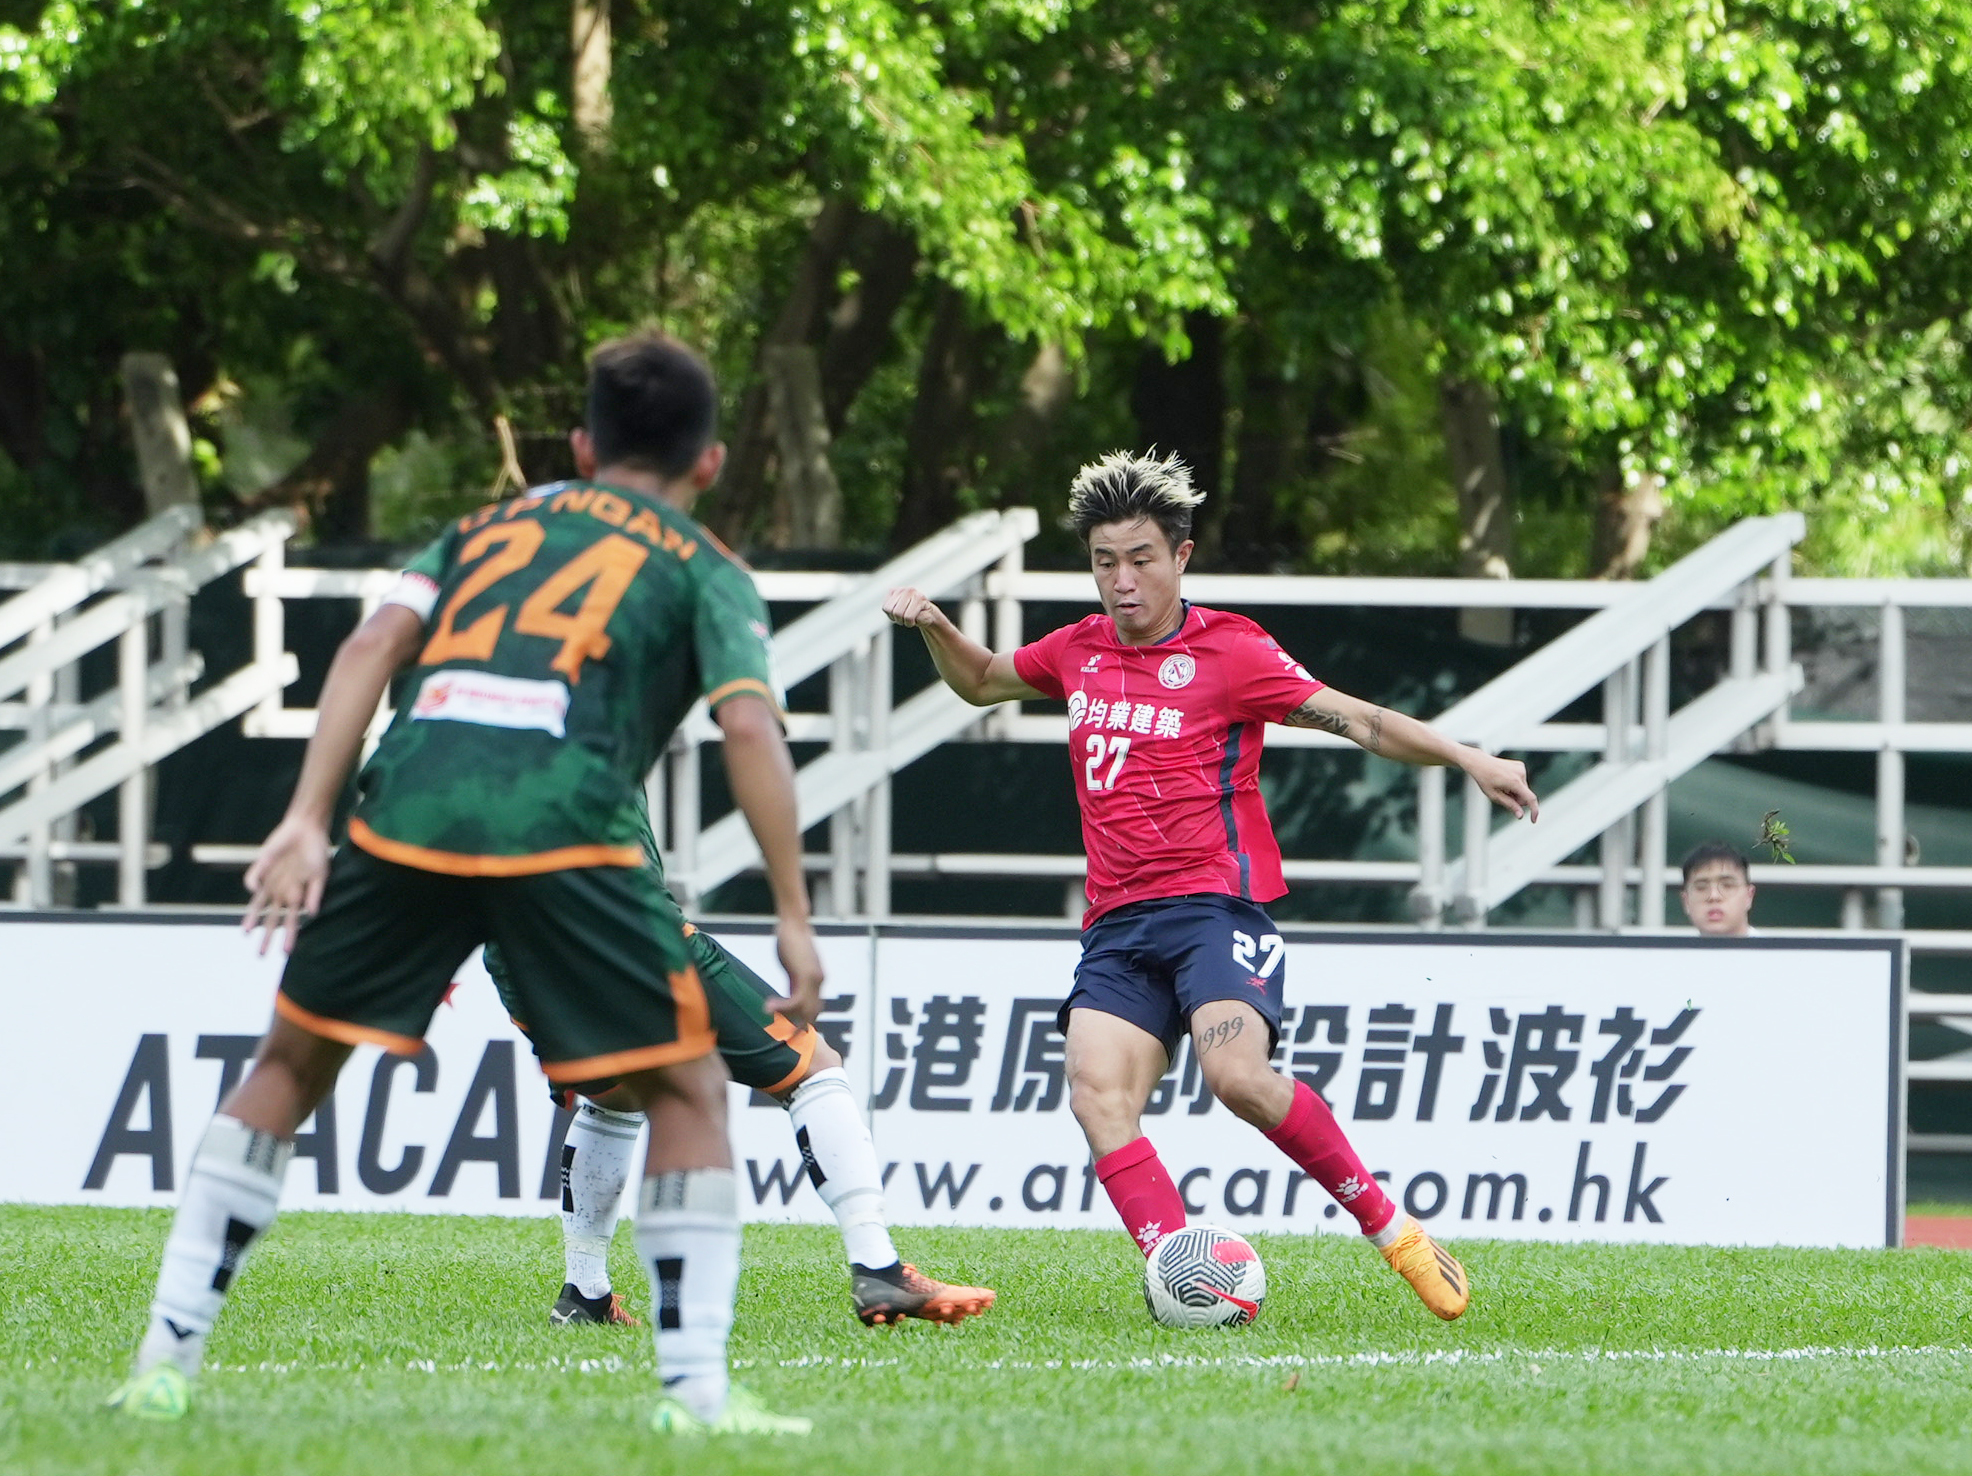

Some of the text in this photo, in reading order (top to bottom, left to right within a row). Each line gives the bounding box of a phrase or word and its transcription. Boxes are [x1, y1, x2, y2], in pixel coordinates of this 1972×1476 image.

[418, 518, 651, 686] 24
[1085, 698, 1185, 739] 均業建築
[1085, 734, 1132, 791] 27
[1233, 930, 1285, 978] 27
[746, 1141, 1670, 1224] ww.atcar.om.hk
